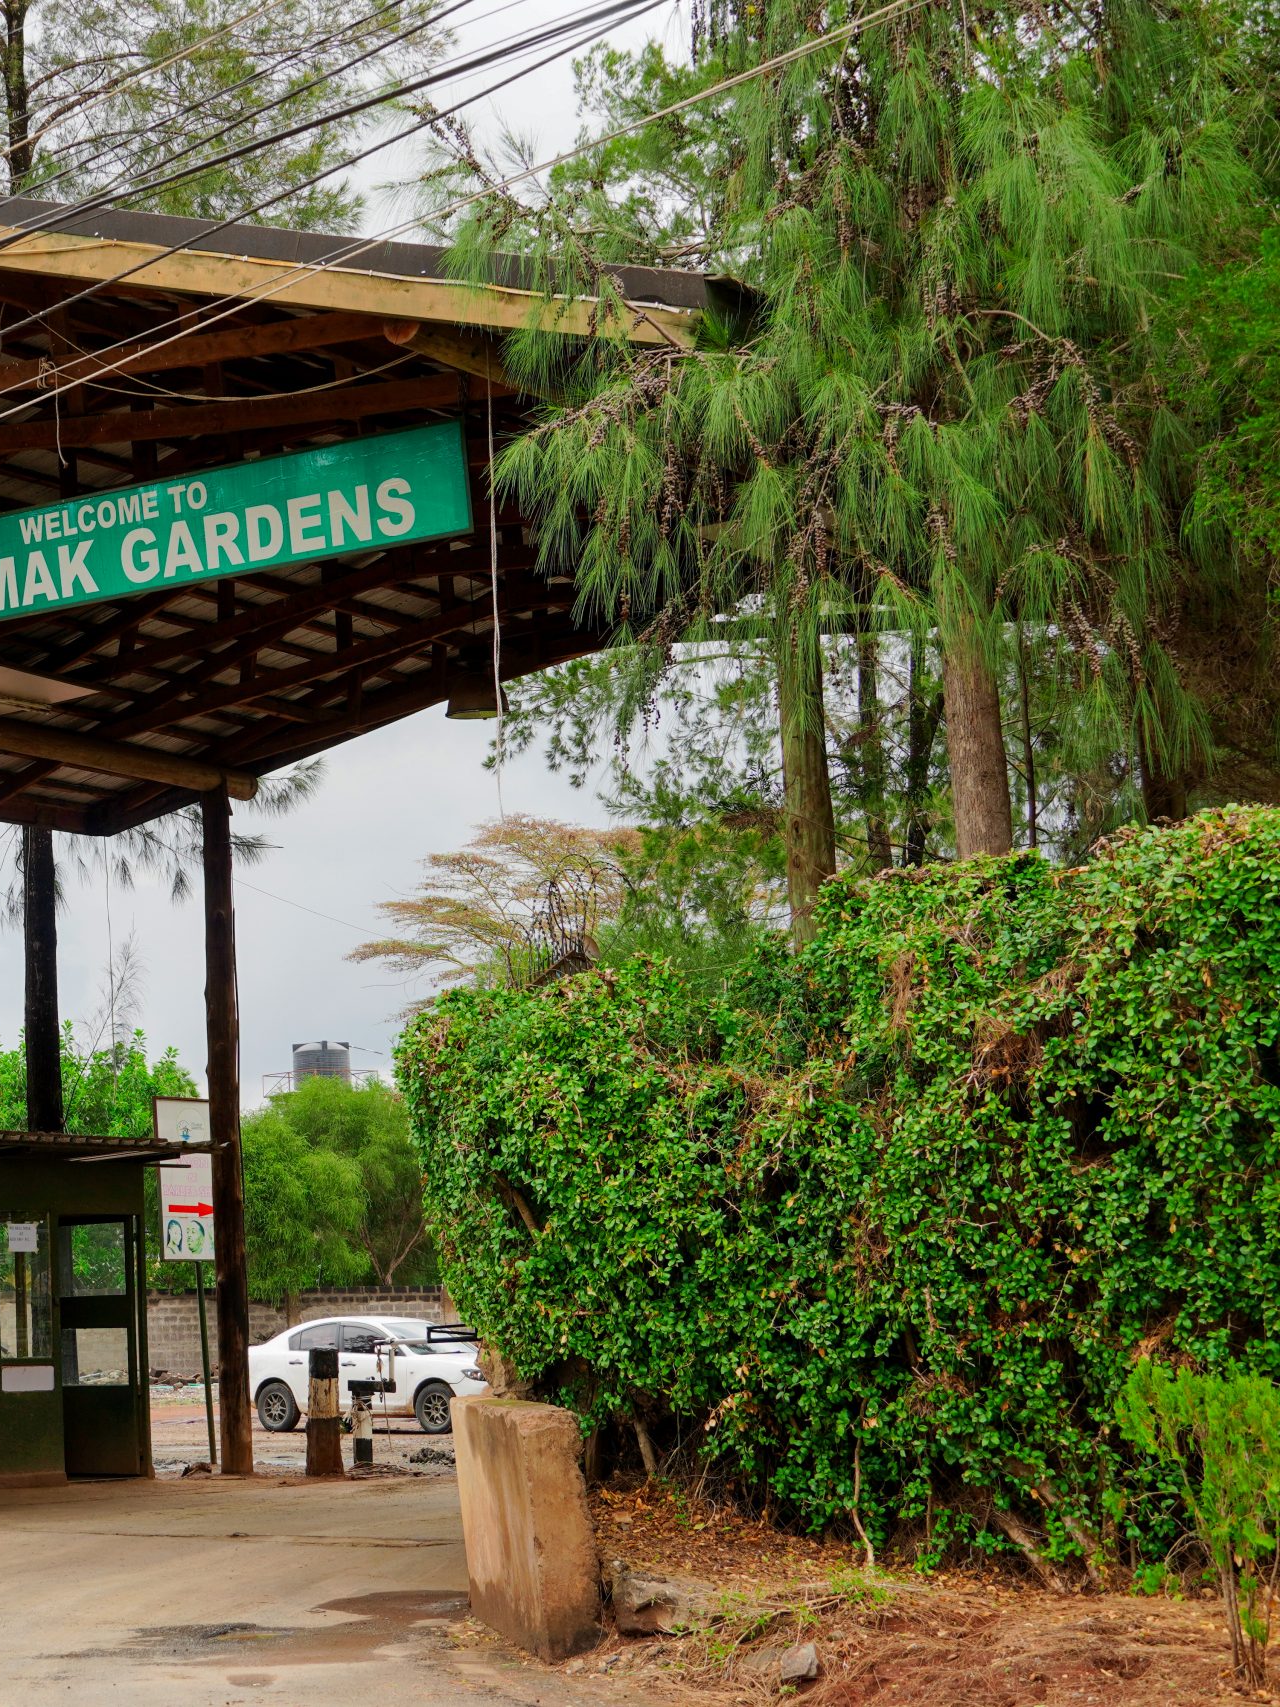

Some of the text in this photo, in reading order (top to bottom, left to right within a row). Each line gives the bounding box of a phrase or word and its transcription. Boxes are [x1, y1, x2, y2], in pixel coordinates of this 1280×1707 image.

[18, 481, 208, 544] WELCOME TO
[120, 477, 417, 584] GARDENS
